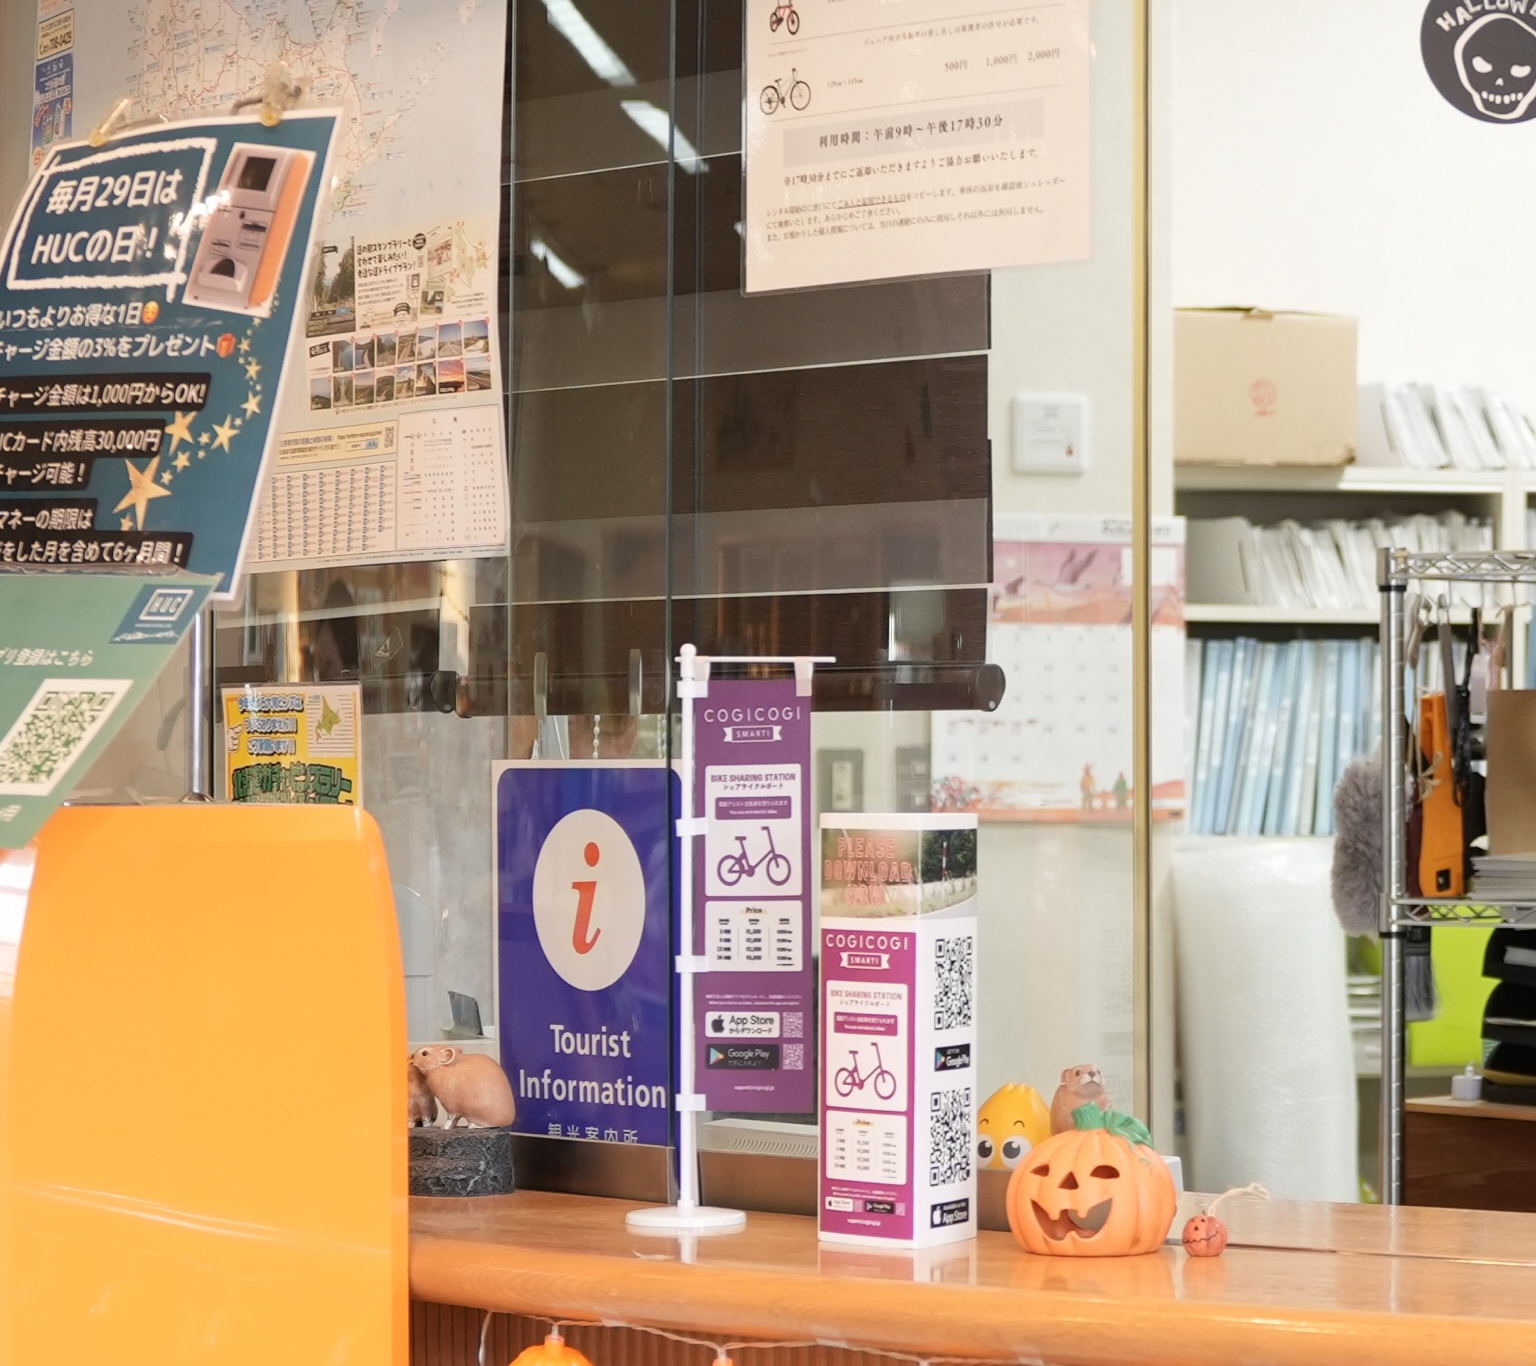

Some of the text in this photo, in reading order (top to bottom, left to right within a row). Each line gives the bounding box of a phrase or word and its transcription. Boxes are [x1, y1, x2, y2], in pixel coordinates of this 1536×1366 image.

[944, 59, 968, 73] 500円
[985, 53, 1018, 68] 1,000円
[1027, 47, 1060, 62] 2,000円
[46, 168, 184, 215] 毎月29日は
[0, 304, 143, 330] いつもよりお得な1日
[0, 428, 161, 453] Cカード内残高30,000円
[0, 540, 183, 564] をした月を含めて6ヶ月間！
[149, 596, 182, 613] HUC
[704, 706, 800, 723] COGICOGI
[736, 729, 770, 738] SMART!
[711, 773, 796, 783] BIKE SHARING STATION
[837, 837, 896, 859] PLEASE
[824, 860, 913, 884] DOWNLOAD
[826, 934, 909, 951] COGICOGI
[850, 955, 880, 965] SMART!
[830, 989, 903, 1001] BIKE SHARING STATION
[729, 1014, 775, 1027] App Store
[550, 1024, 632, 1059] Tourist
[727, 1048, 770, 1060] Google Play
[519, 1069, 667, 1109] Information
